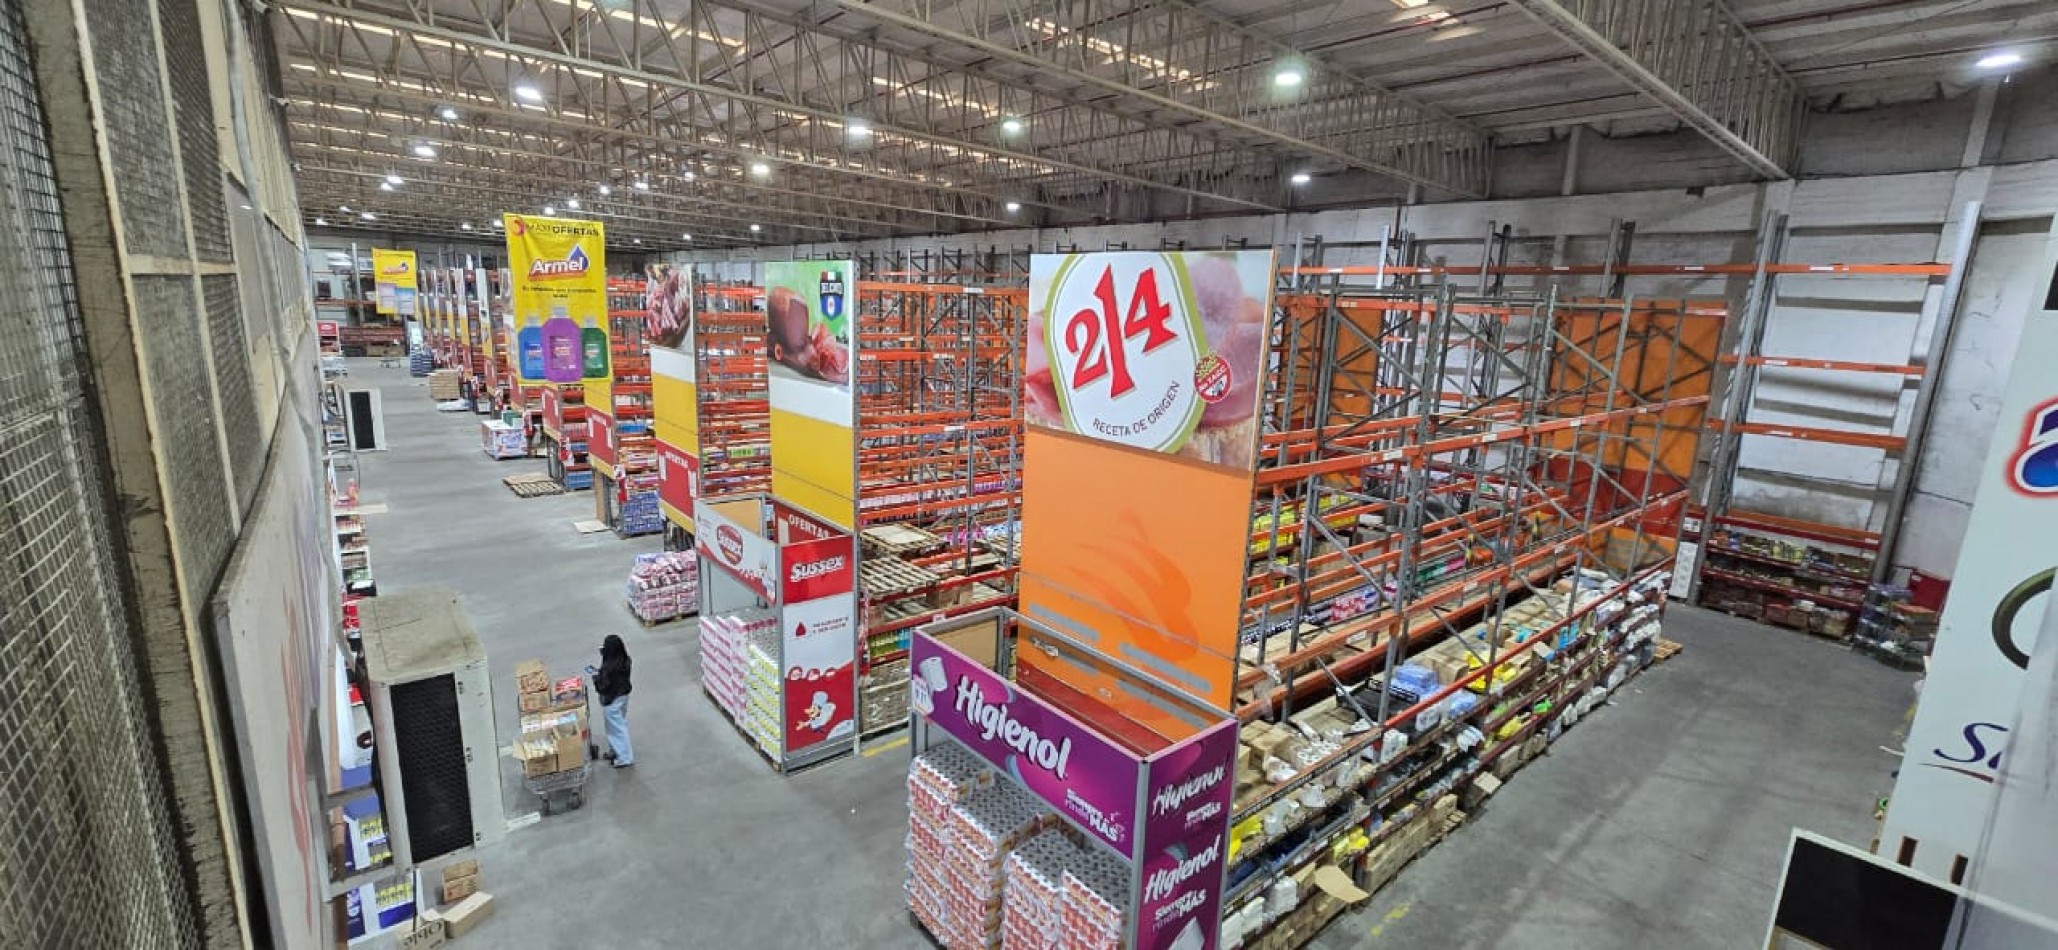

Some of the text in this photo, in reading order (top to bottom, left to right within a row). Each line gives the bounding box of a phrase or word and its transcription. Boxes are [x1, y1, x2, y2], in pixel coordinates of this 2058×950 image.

[529, 257, 584, 275] Armel
[1093, 380, 1181, 436] RECETA DE ORIGEN
[790, 556, 845, 583] Sussex
[955, 674, 1072, 780] Higienol
[1144, 833, 1221, 904] Higienol
